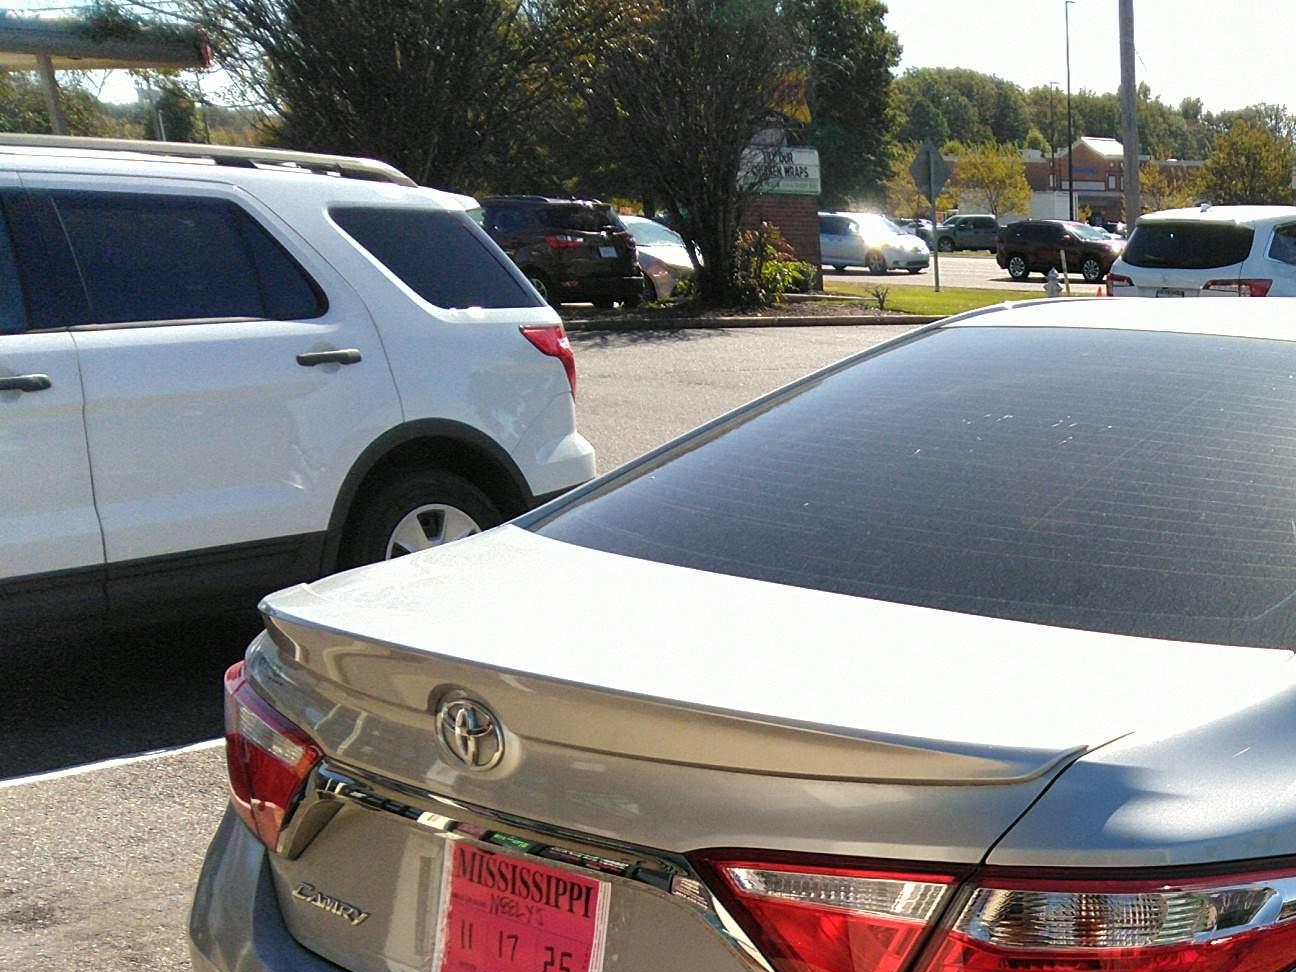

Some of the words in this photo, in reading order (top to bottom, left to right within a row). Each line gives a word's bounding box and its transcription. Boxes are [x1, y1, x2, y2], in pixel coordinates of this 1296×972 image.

[784, 166, 809, 178] WRAPS
[292, 881, 371, 926] CAMRY
[457, 847, 594, 919] MISSISSIPPI
[460, 919, 473, 949] 11
[498, 930, 520, 961] 17
